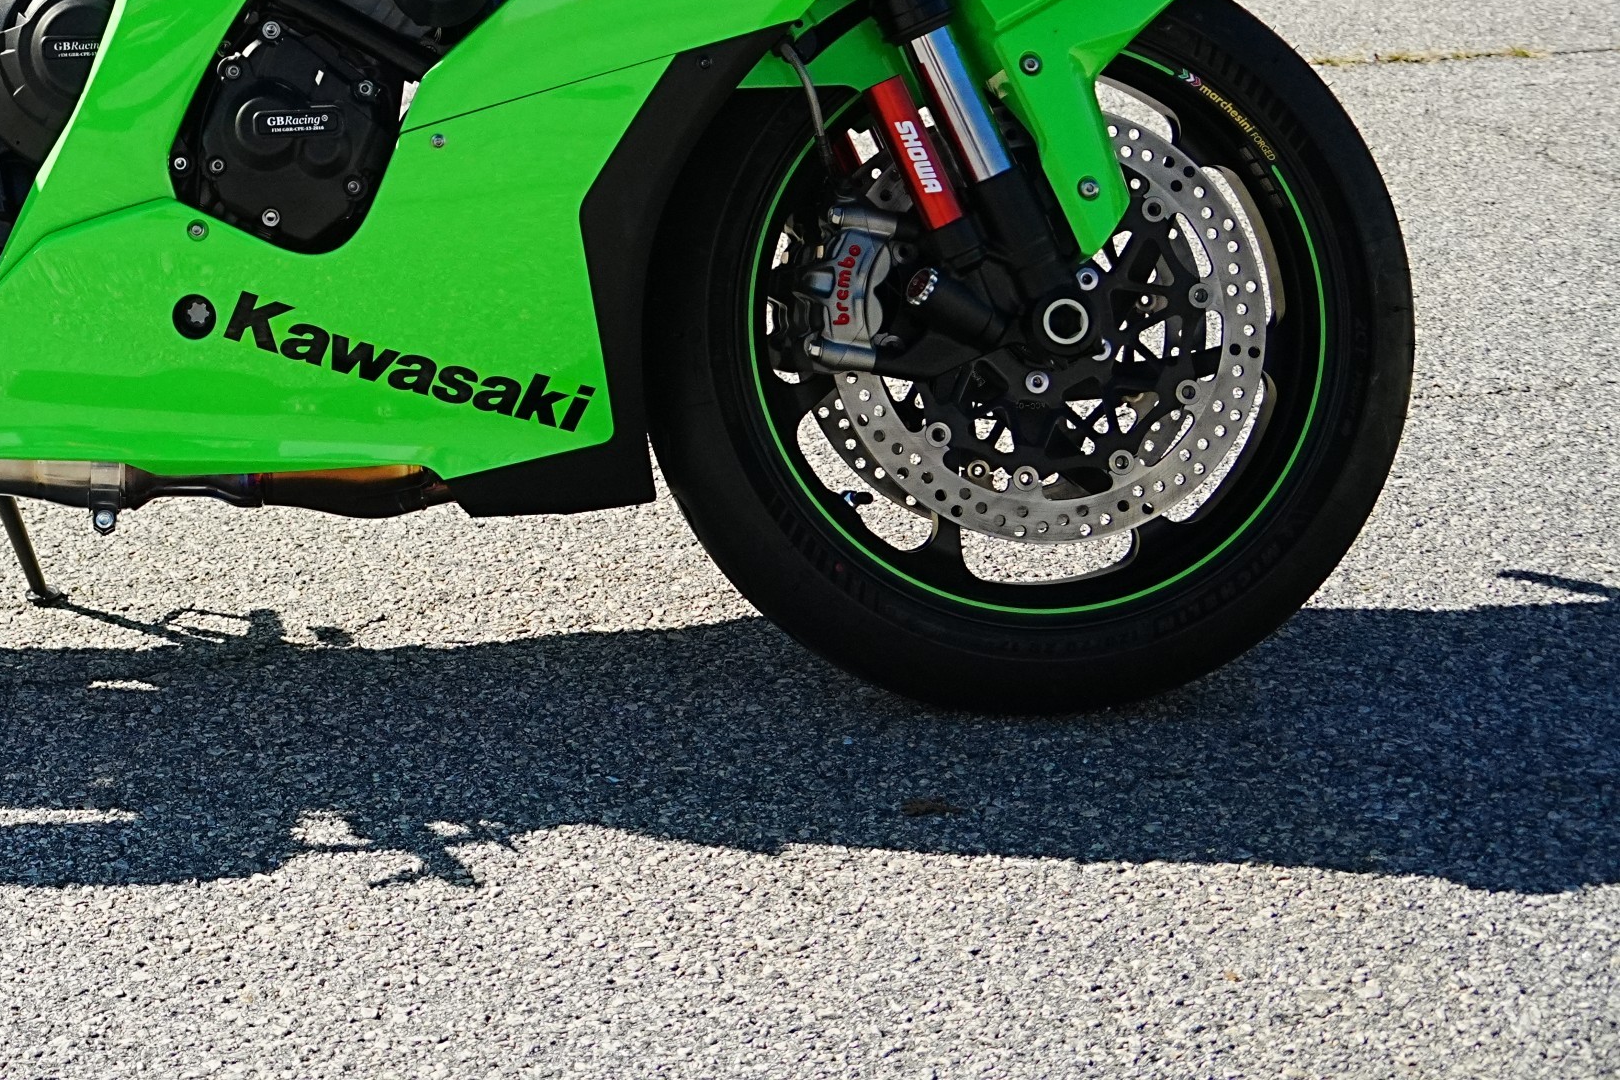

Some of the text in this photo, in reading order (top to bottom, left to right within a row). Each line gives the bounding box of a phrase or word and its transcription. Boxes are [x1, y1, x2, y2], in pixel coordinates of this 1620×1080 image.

[54, 41, 100, 51] GBRacin
[894, 120, 943, 194] SHOWA
[1199, 84, 1276, 161] marchesini FORGED
[833, 244, 861, 326] brembo
[223, 290, 596, 433] Kawasaki
